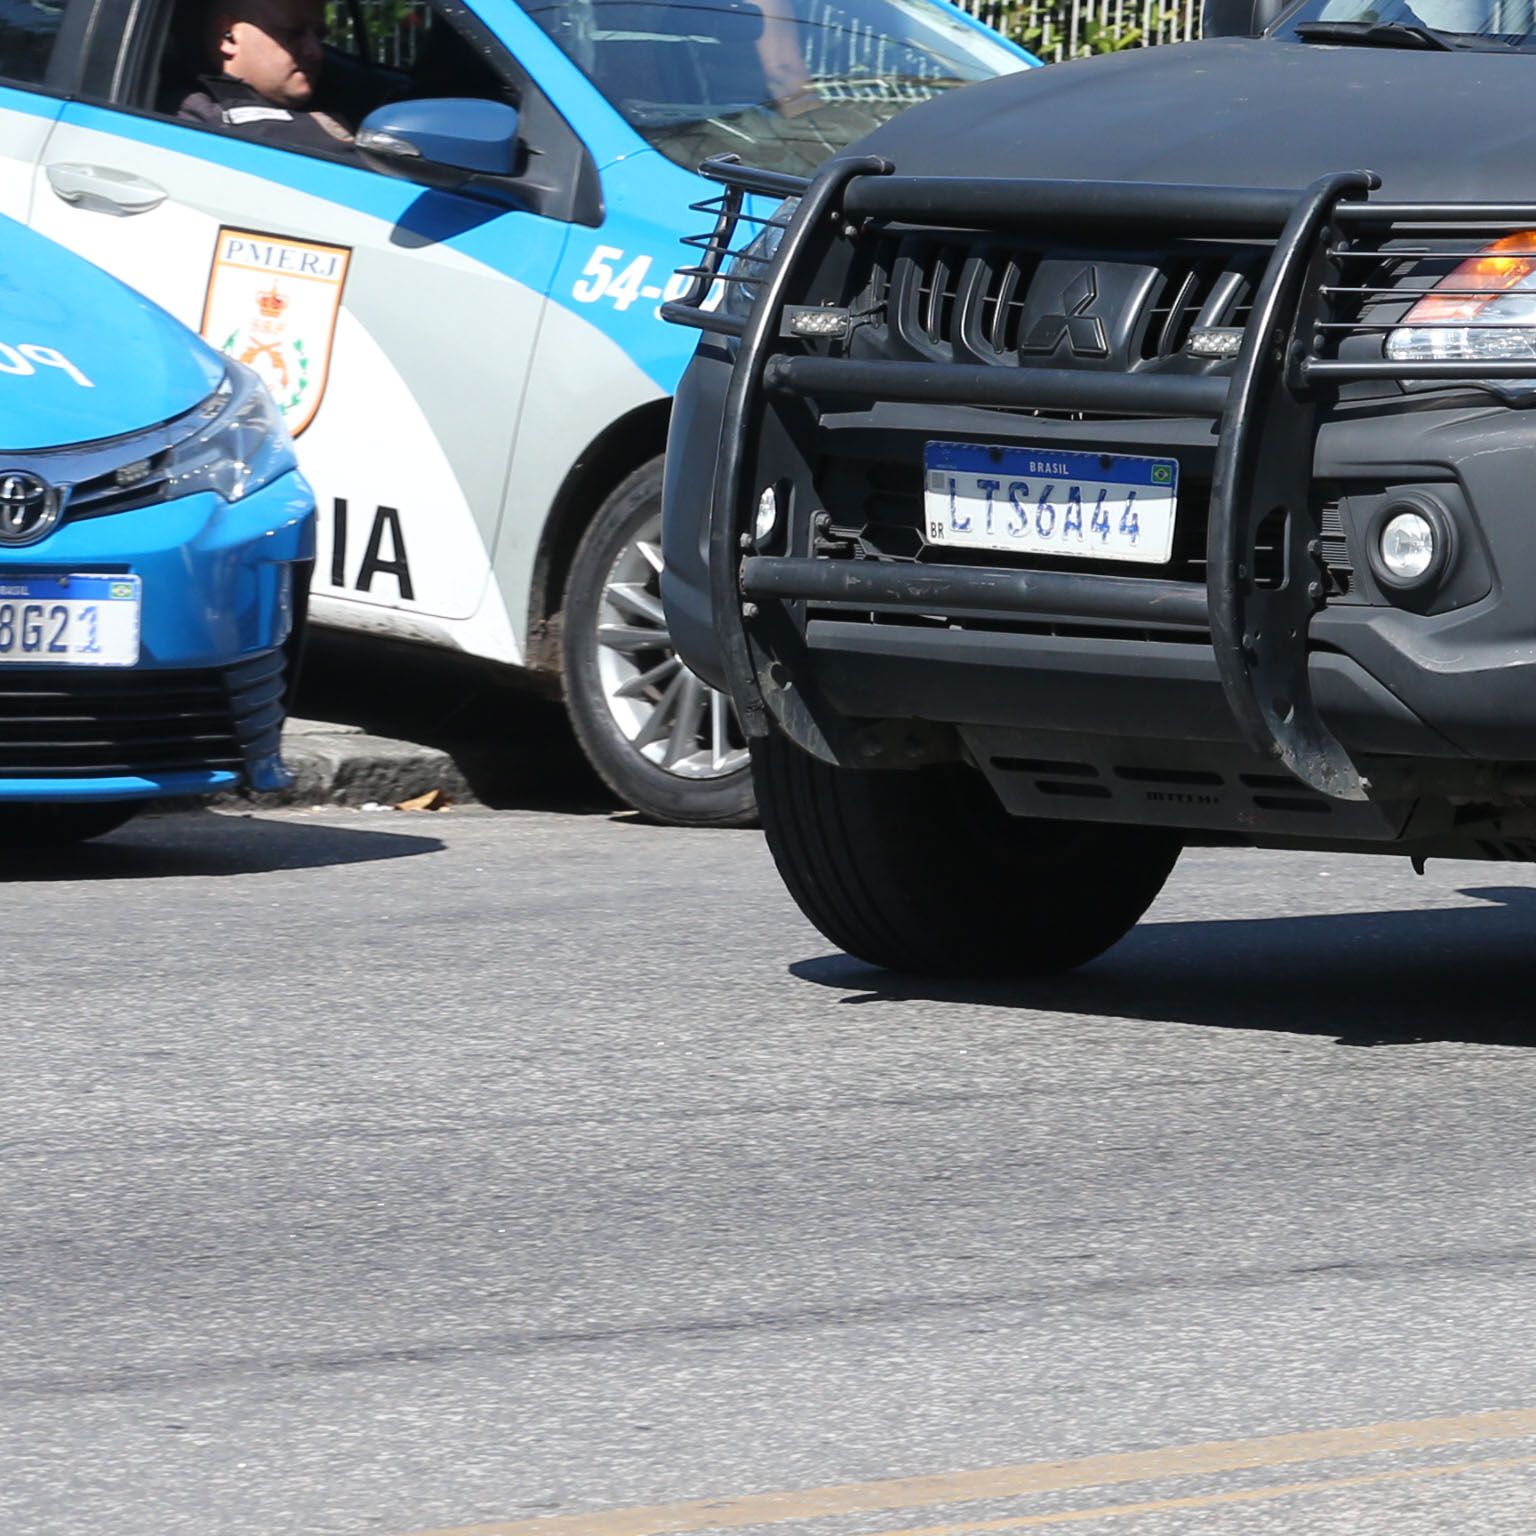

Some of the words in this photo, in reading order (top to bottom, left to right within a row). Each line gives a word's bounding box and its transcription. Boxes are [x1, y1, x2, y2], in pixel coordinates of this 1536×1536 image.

[225, 239, 339, 277] PMERJ
[1028, 461, 1070, 475] BRASIL
[949, 477, 1140, 544] LTS6A44
[930, 522, 945, 539] BR
[0, 603, 101, 653] 8G21
